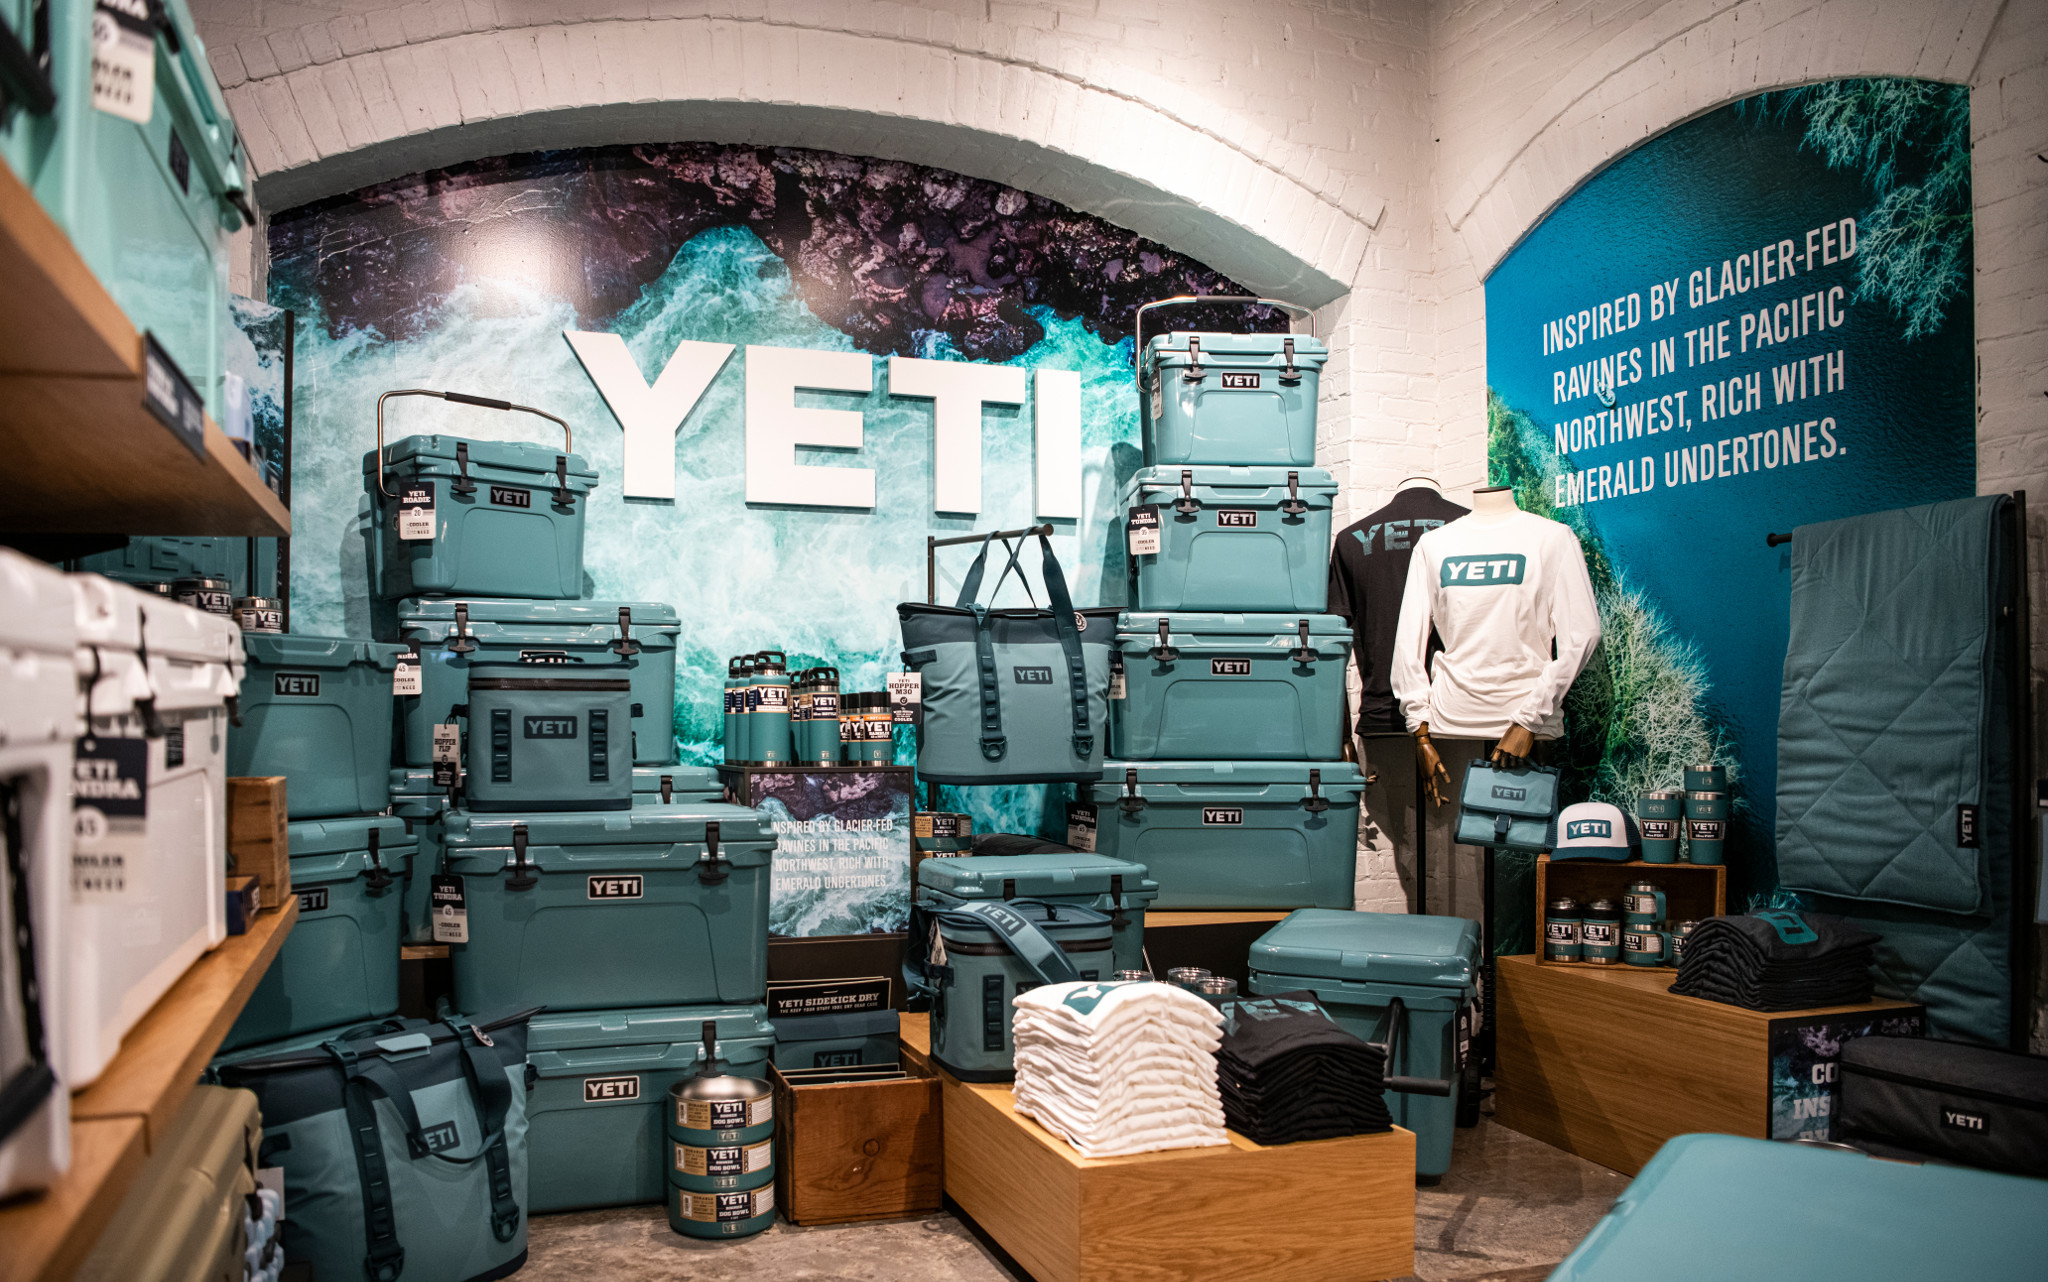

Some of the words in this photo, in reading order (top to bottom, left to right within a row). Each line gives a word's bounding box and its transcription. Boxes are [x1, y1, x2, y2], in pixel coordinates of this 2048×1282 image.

[1543, 293, 1641, 356] INSPIRED
[1651, 278, 1680, 322] BY
[1689, 217, 1857, 309] GLACIER-FED
[1553, 347, 1642, 405] RAVINES
[1651, 337, 1675, 378] IN
[1685, 320, 1731, 368] THE
[1740, 285, 1845, 353] PACIFIC
[1224, 375, 1259, 387] YETI
[1554, 390, 1692, 456] NORTHWEST,
[1702, 372, 1761, 423] RICH
[1772, 350, 1845, 405] WITH
[562, 330, 1082, 519] YETI
[1555, 456, 1655, 508] EMERALD
[1664, 416, 1847, 488] UNDERTONES.
[492, 489, 527, 505] YETI
[1220, 513, 1255, 525] YETI
[1447, 559, 1517, 580] YETI
[199, 592, 231, 606] YETI
[1214, 661, 1249, 673] YETI
[1017, 670, 1050, 681] YETI
[276, 677, 316, 693] YETI
[758, 687, 788, 699] YETI
[813, 697, 836, 706] YETI
[528, 721, 573, 734] YETI
[865, 722, 892, 732] YETI
[1495, 788, 1523, 798] YETI
[935, 817, 956, 826] YETI
[1206, 811, 1240, 822] YETI
[819, 820, 831, 832] BY
[834, 818, 893, 832] GLACIER-FED
[1570, 822, 1606, 835] YETI
[1643, 822, 1667, 830] YETI
[1693, 822, 1718, 830] YETI
[1962, 809, 1973, 843] YETI
[819, 839, 829, 851] IN
[833, 838, 851, 851] THE
[853, 837, 889, 851] PACIFIC
[839, 857, 861, 870] RICH
[864, 855, 889, 869] WITH
[592, 880, 638, 895] YETI
[775, 876, 821, 890] EMERALD
[824, 874, 889, 889] UNDERTONES.
[298, 892, 325, 909] ETI
[433, 893, 463, 901] TUNDRA
[983, 905, 1021, 931] YETI
[1546, 924, 1572, 934] YETI
[1583, 924, 1609, 935] YETI
[778, 998, 803, 1008] YETI
[805, 995, 857, 1006] SIDEKICK
[858, 993, 880, 1002] DRY
[818, 1053, 858, 1067] YETI
[587, 1081, 634, 1097] YETI
[714, 1102, 743, 1113] YETI
[1946, 1111, 1983, 1130] YETI
[711, 1149, 739, 1159] YETI
[720, 1194, 748, 1206] YETI
